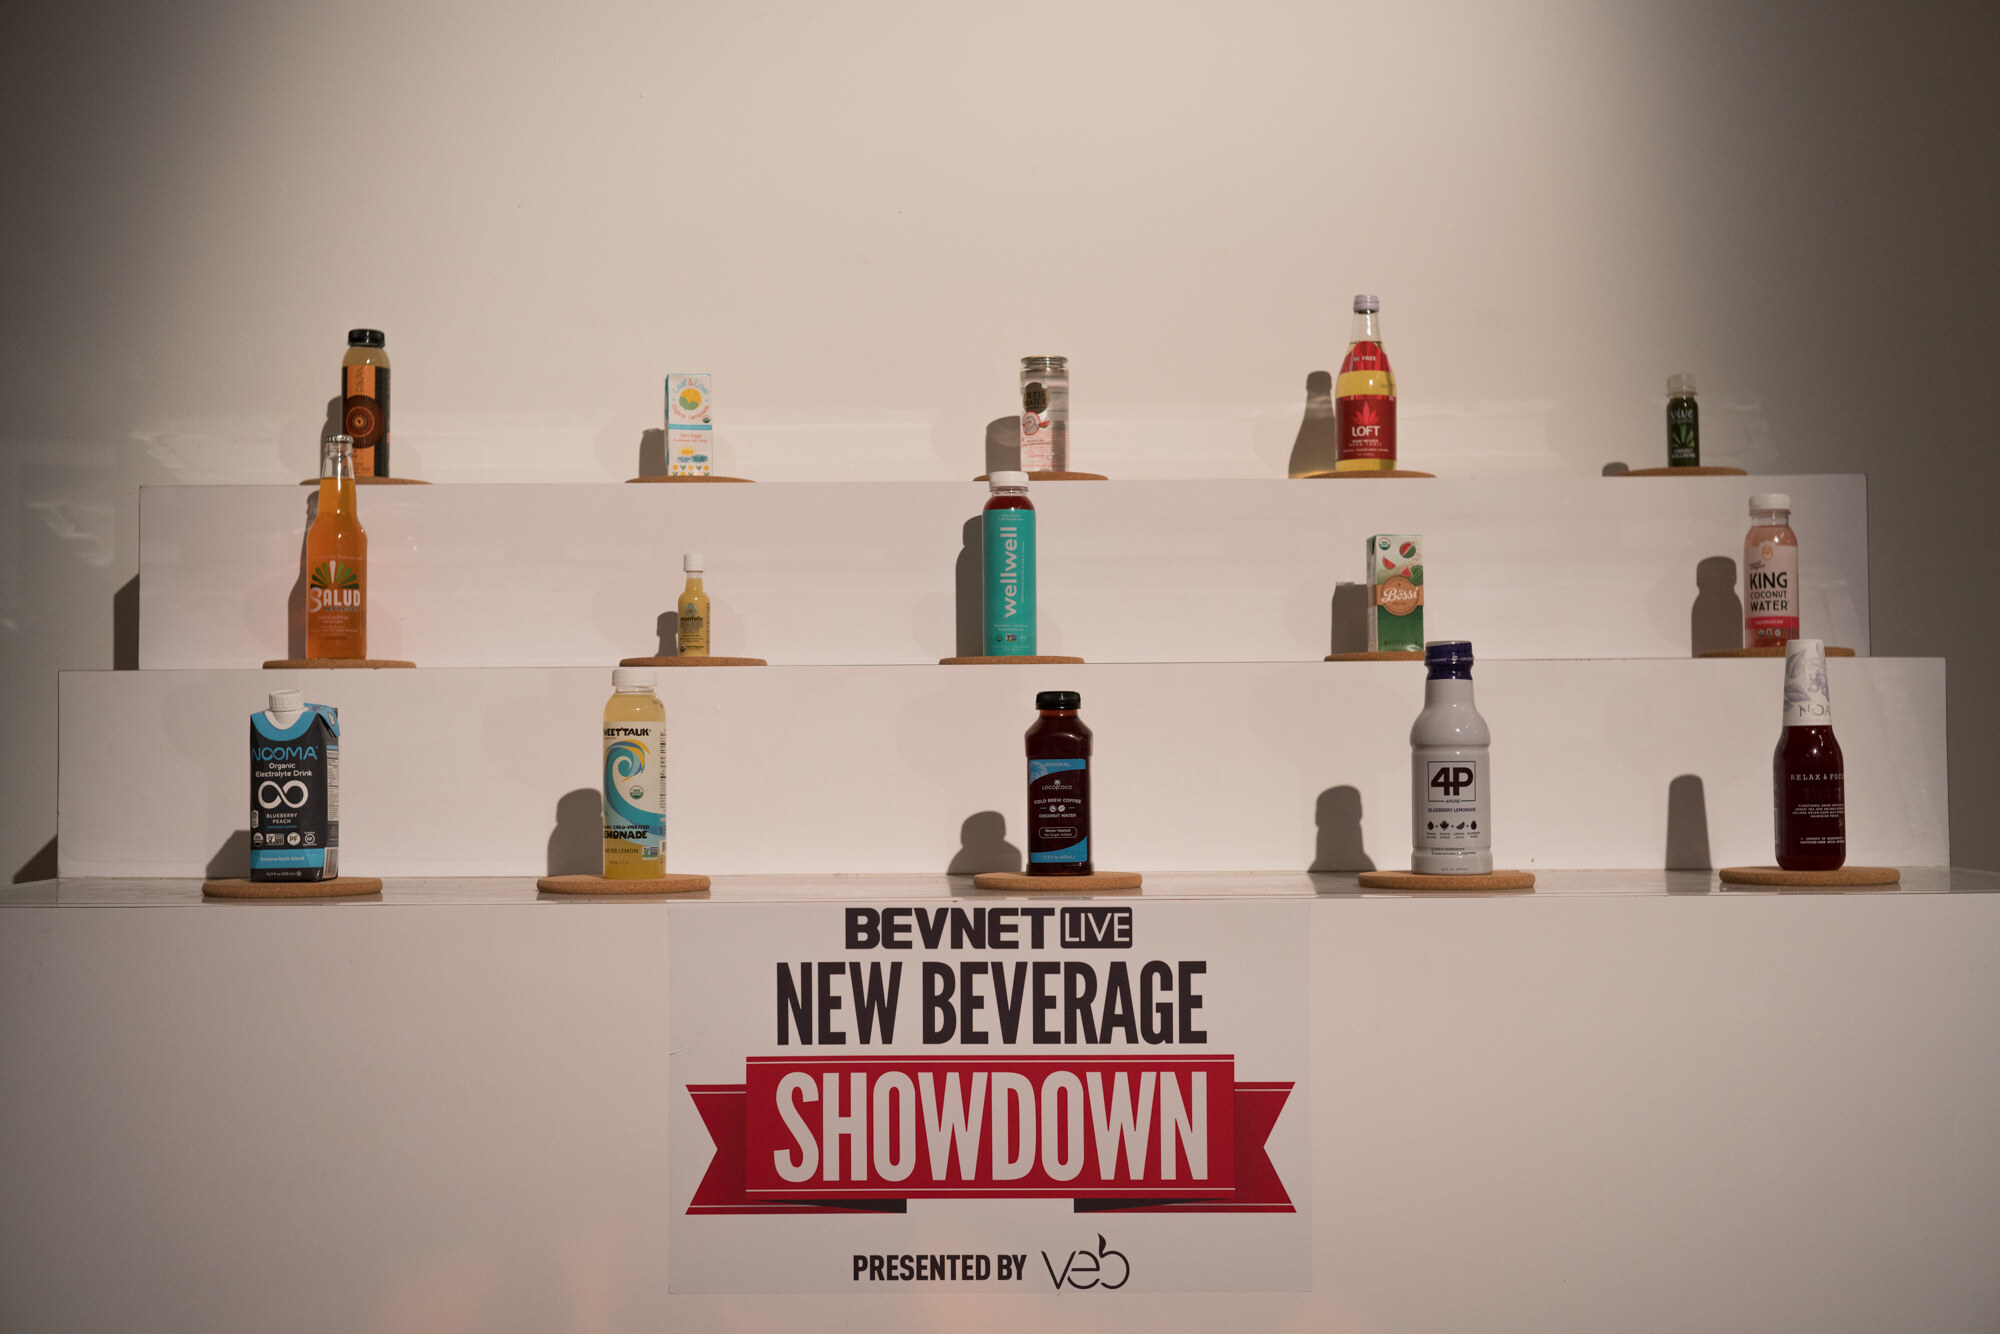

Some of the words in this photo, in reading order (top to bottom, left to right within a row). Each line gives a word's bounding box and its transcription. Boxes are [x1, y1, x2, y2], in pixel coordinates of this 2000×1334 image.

[1352, 425, 1380, 437] LOFT
[1000, 526, 1018, 618] wellwell
[1750, 572, 1788, 590] KING
[308, 586, 360, 612] SALUD
[1750, 590, 1788, 599] COCONUT
[1750, 600, 1788, 612] WATER
[252, 746, 318, 761] NOOMA
[255, 770, 292, 778] Electrolyte
[1430, 767, 1474, 796] 4P
[845, 907, 1055, 949] BEVNET
[1064, 911, 1131, 944] LIVE
[777, 961, 903, 1045] NEW
[922, 960, 1207, 1045] BEVERAGE
[773, 1070, 1208, 1183] SHOWDOWN
[853, 1254, 991, 1281] PRESENTED
[997, 1254, 1027, 1281] BY
